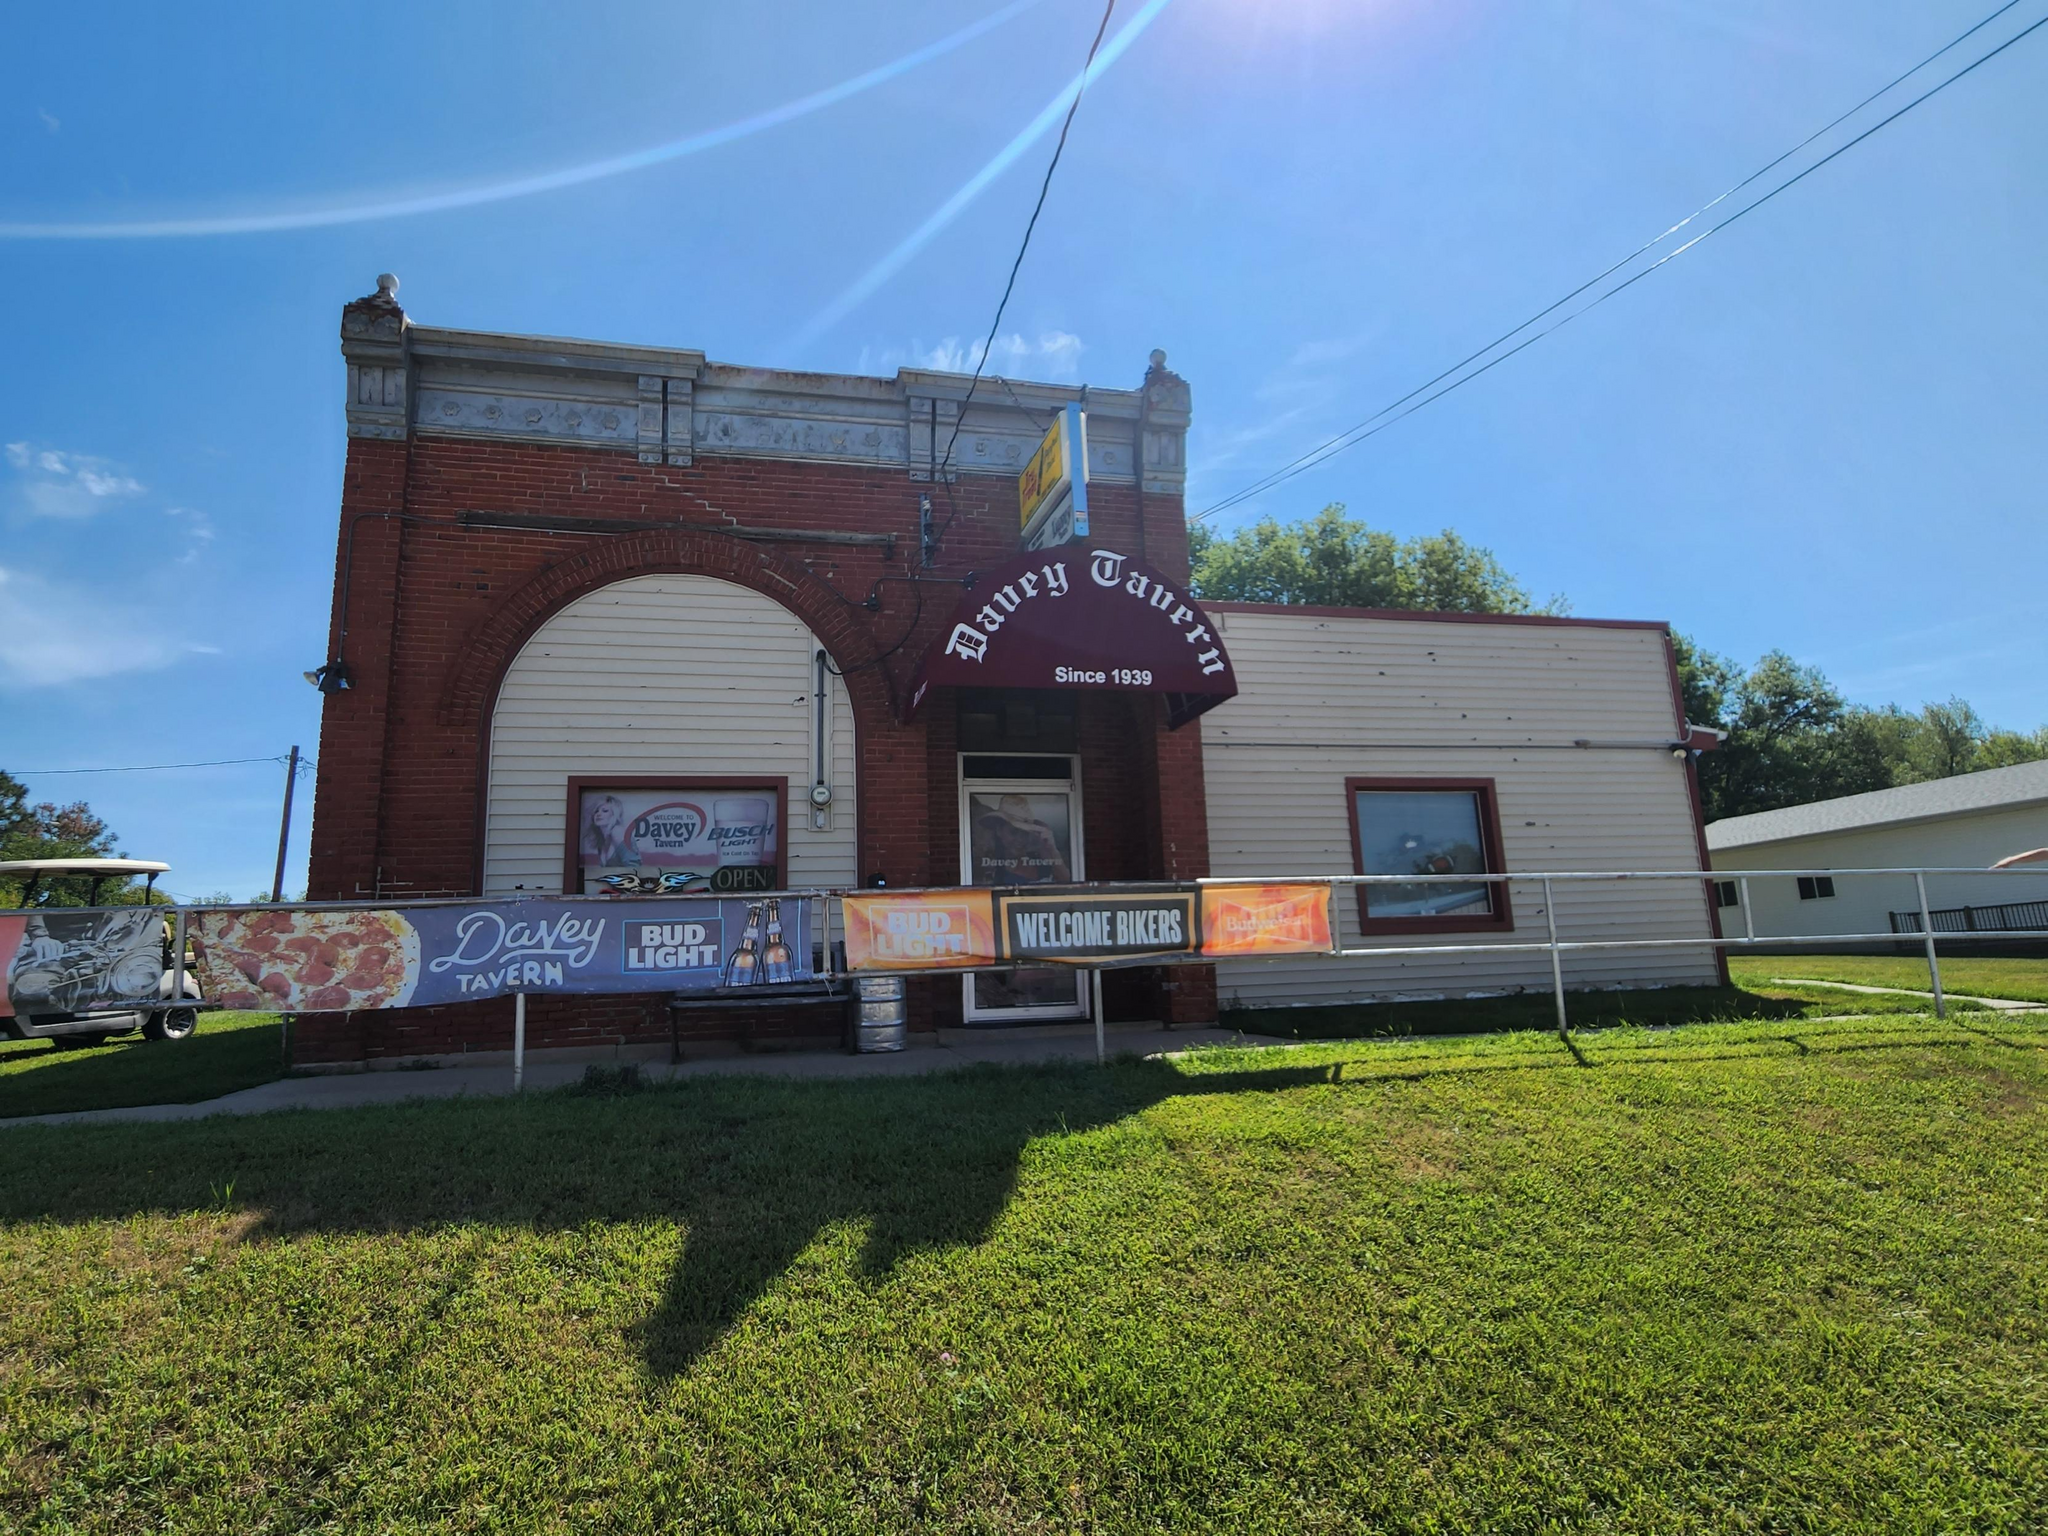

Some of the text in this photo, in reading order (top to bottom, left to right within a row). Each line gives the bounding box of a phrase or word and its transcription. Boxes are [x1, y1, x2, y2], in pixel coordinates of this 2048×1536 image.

[945, 550, 1226, 676] Davey Tavern
[1055, 666, 1153, 685] Since 1939
[634, 817, 696, 842] Davey
[707, 824, 775, 841] BUSCH
[653, 838, 684, 848] Tavern
[721, 839, 759, 847] LIGHT
[981, 856, 1062, 868] Davey Tavern
[717, 868, 767, 888] OPEN
[888, 912, 951, 934] BUD
[1016, 909, 1183, 948] WELCOME BIKERS
[429, 911, 606, 973] Davey
[641, 924, 706, 947] BUD
[877, 934, 964, 956] LIGHT
[628, 945, 718, 969] LIGHT
[456, 961, 563, 992] TAVERN
